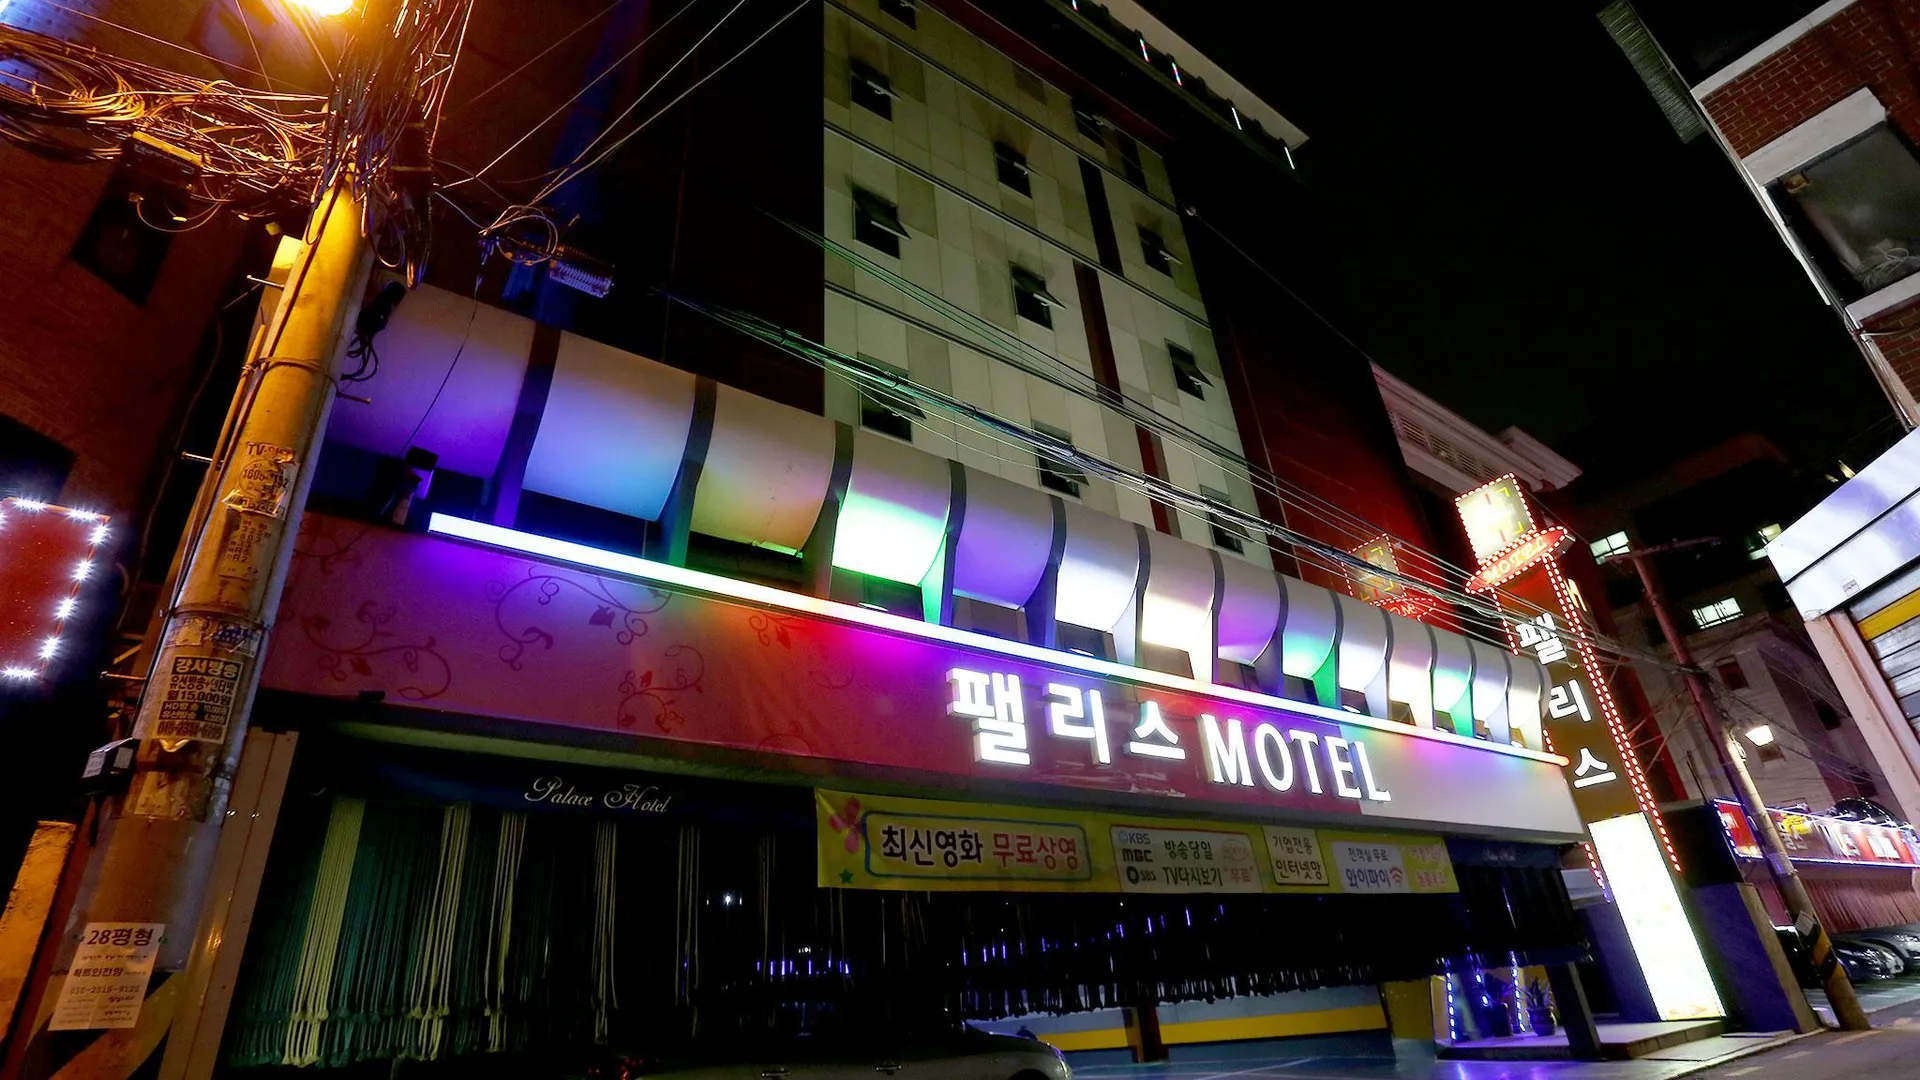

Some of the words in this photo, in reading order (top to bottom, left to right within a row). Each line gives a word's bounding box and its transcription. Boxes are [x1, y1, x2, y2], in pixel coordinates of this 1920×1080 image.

[175, 658, 239, 679] 강서방송
[1515, 612, 1617, 789] 팰리스
[946, 667, 1186, 766] 팰리스
[1199, 713, 1391, 802] MOTEL
[524, 776, 593, 806] Palace
[603, 784, 672, 813] Hotel
[881, 825, 984, 868] 최신영화
[992, 832, 1079, 870] 무료상영
[1128, 832, 1151, 845] KBS
[1272, 836, 1313, 855] 기업전용
[1163, 840, 1214, 861] 방송당일
[1162, 866, 1223, 887] TV다시보기
[1276, 859, 1322, 880] 인터넷망
[1345, 868, 1391, 888] 와이파이
[87, 927, 153, 947] 28평형
